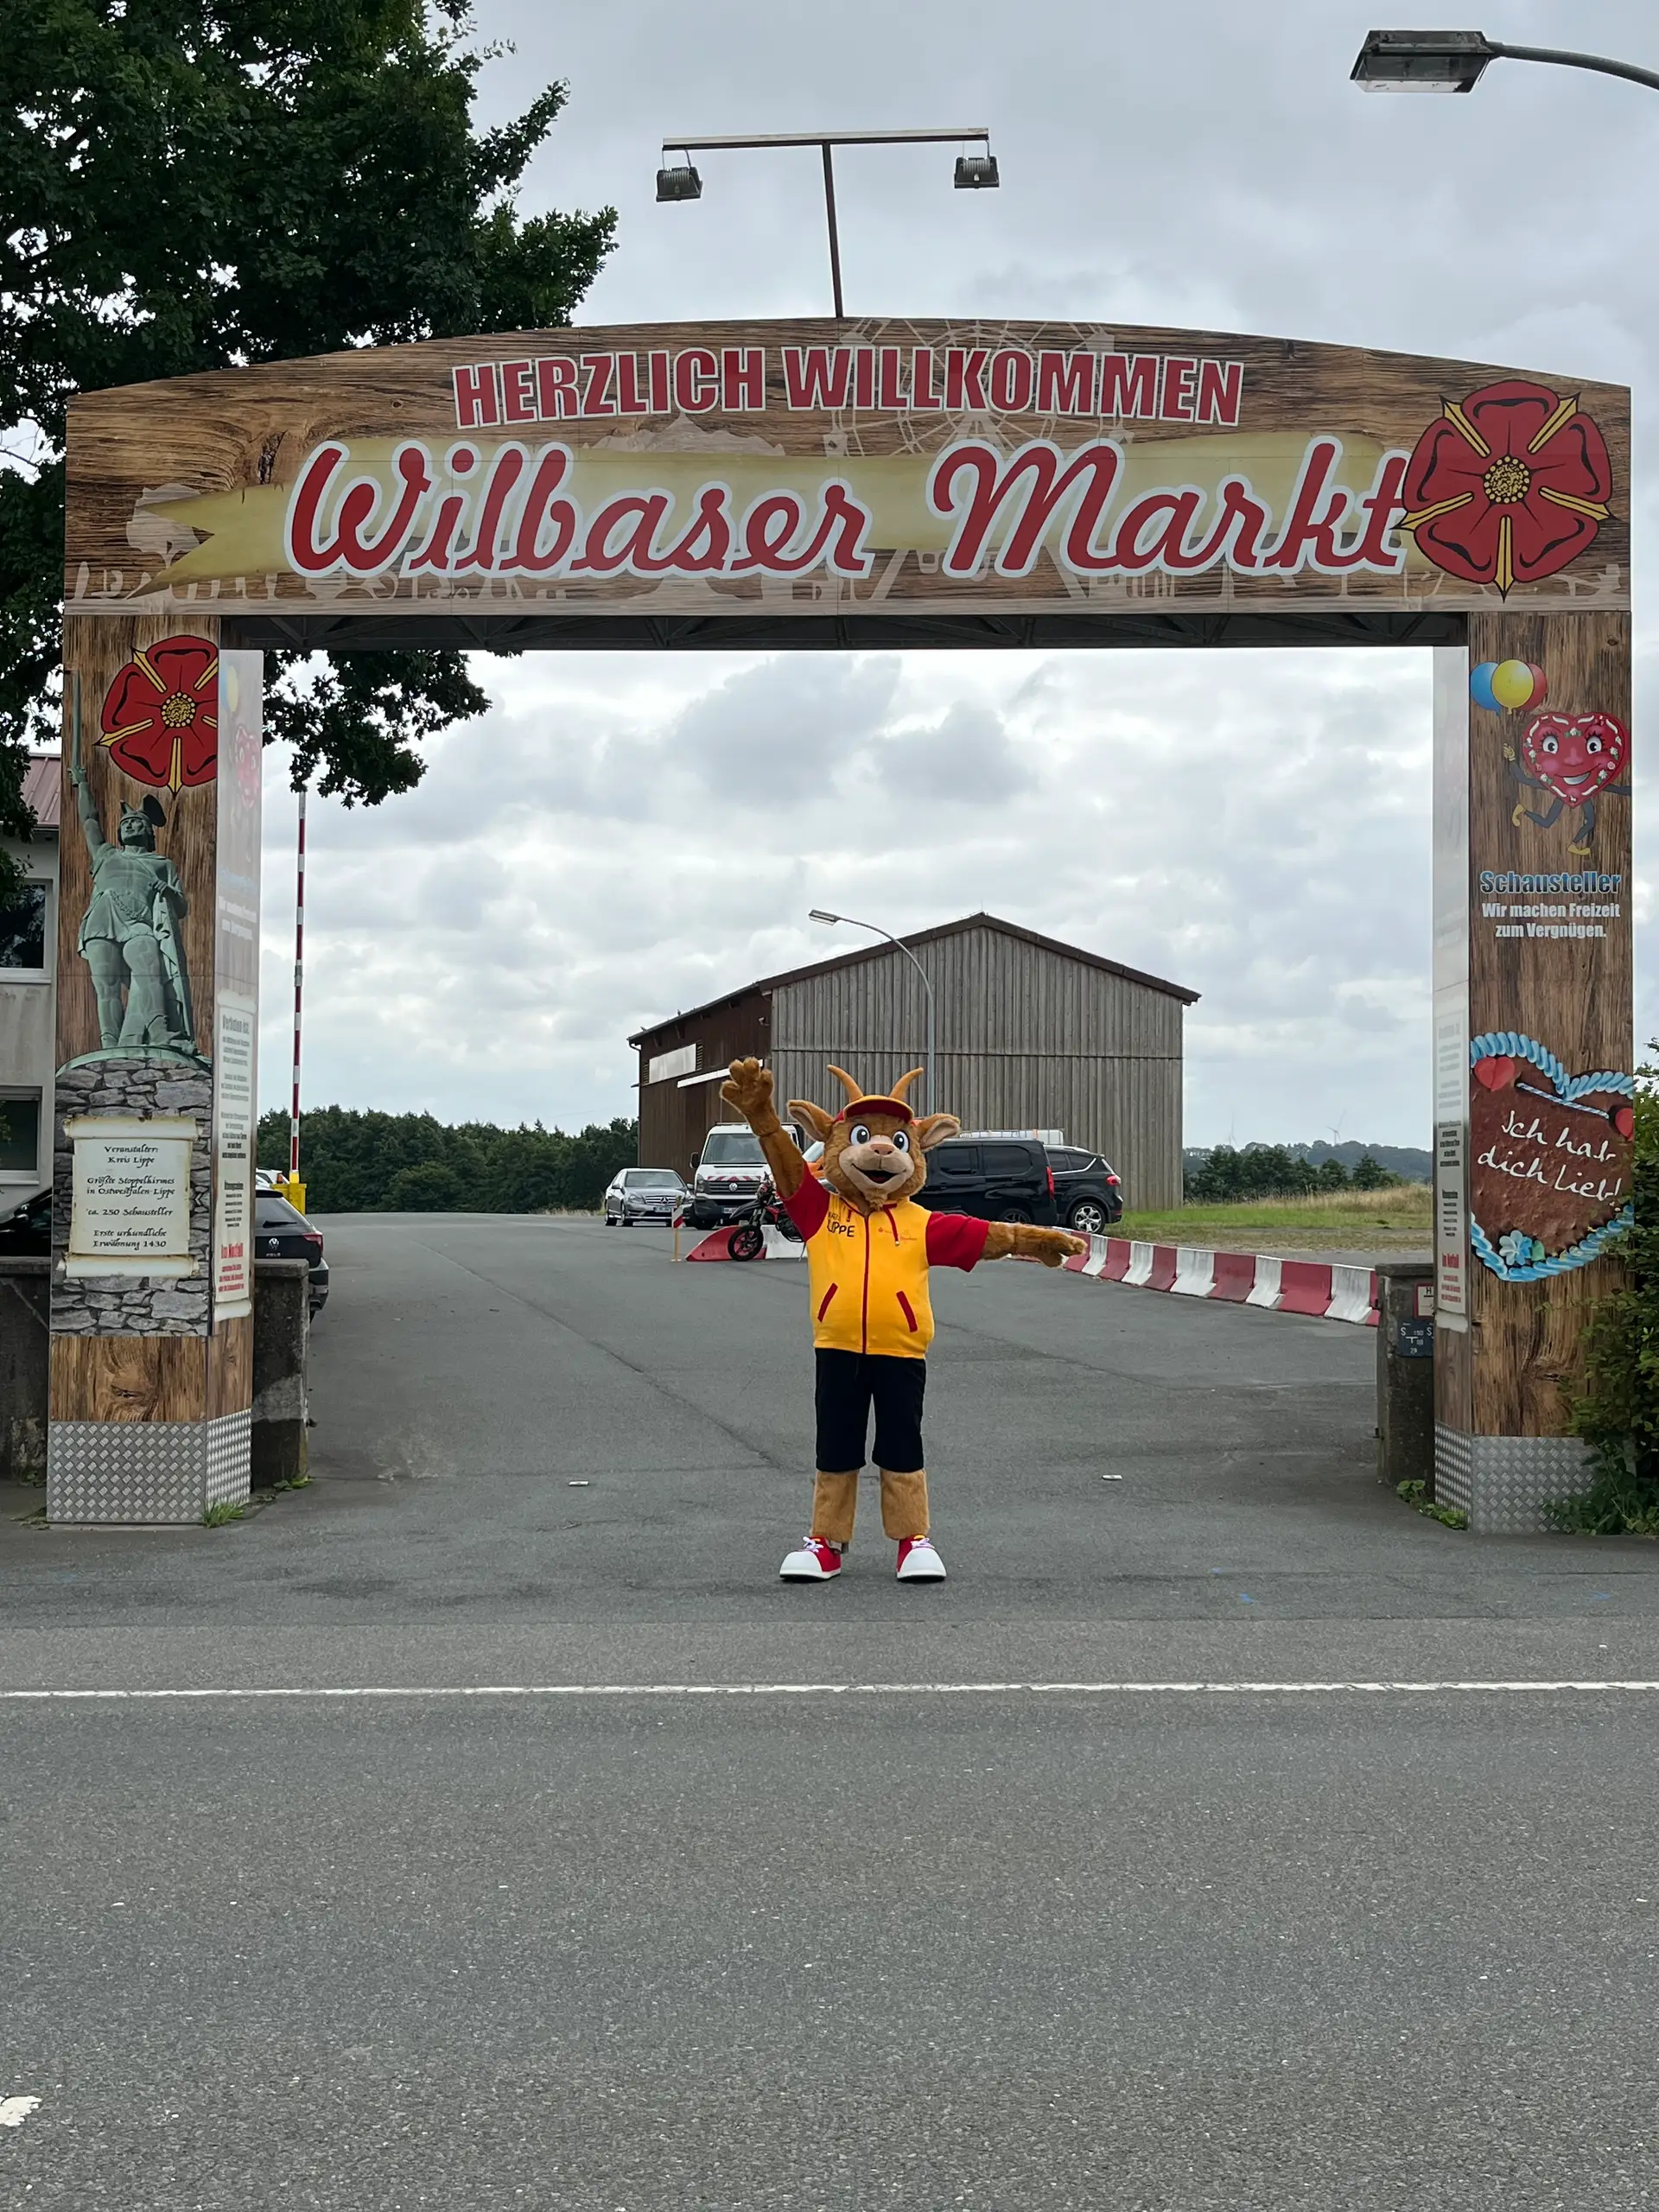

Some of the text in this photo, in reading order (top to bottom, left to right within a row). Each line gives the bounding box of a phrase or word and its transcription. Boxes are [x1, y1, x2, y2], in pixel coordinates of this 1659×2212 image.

[452, 345, 1245, 429] HERZLICH WILLKOMMEN
[283, 435, 1413, 580] Wilbaser Markt
[1480, 870, 1621, 893] Schausteller
[1482, 902, 1621, 918] Wir machen Freizeit
[1495, 922, 1606, 939] zum Vergnügen.
[1501, 1109, 1547, 1146] Ich
[1555, 1127, 1617, 1162] hab
[105, 1143, 158, 1153] Veranstalter:
[133, 1155, 155, 1168] Lippe
[1478, 1146, 1548, 1185] dich
[87, 1175, 175, 1187] Größte Stoppelkirmes
[123, 1207, 173, 1216] Schausteller
[118, 1228, 167, 1236] urkundliche
[1400, 1327, 1407, 1336] S
